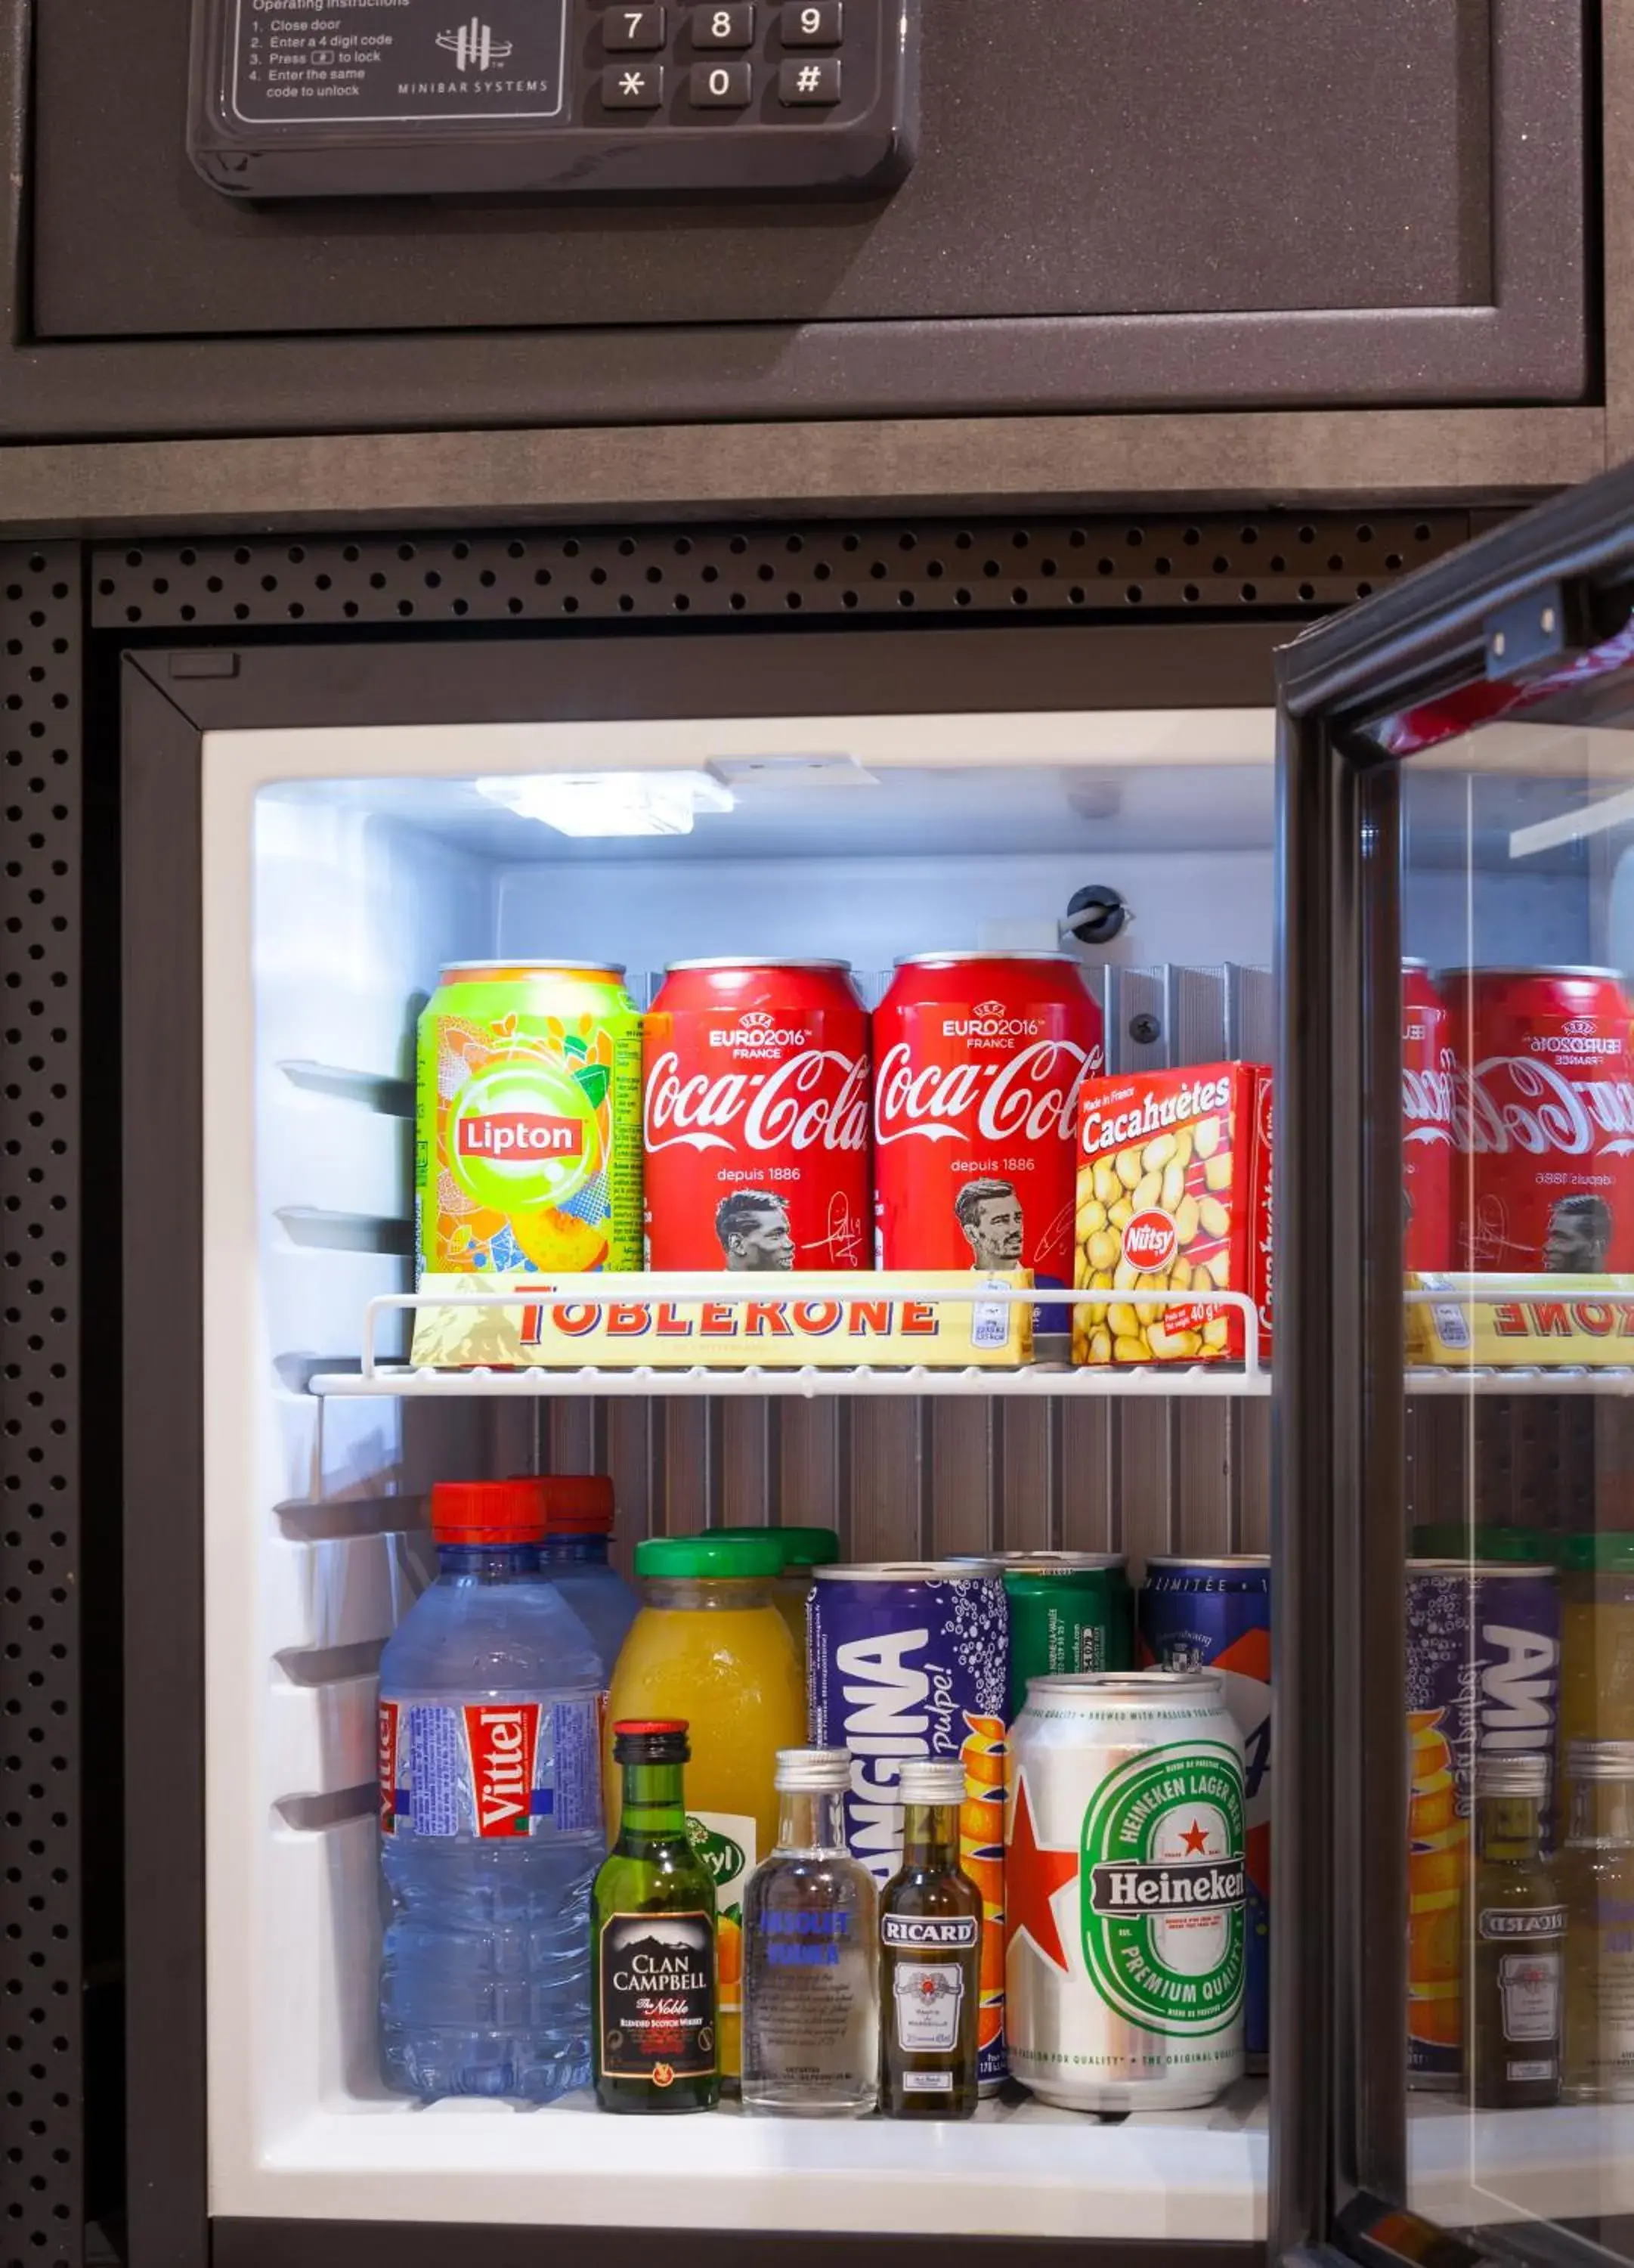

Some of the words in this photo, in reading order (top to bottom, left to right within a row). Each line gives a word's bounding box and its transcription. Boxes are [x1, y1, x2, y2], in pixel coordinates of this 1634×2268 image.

[271, 20, 308, 31] Close
[311, 19, 341, 30] door
[623, 12, 644, 39] 7
[710, 11, 732, 38] 8
[800, 8, 821, 34] 9
[270, 36, 305, 48] Enter
[308, 39, 316, 48] a
[318, 36, 327, 47] 4
[330, 36, 357, 49] digit
[361, 34, 393, 46] code
[269, 52, 307, 64] Press
[339, 51, 351, 63] to
[354, 50, 382, 62] lock
[268, 70, 303, 81] Enter
[306, 69, 326, 79] the
[330, 69, 365, 79] same
[398, 82, 468, 94] MINIBAR
[474, 80, 548, 92] SYSTEMS
[709, 69, 729, 95] 0
[797, 66, 822, 92] #
[267, 86, 298, 98] code
[302, 85, 314, 97] to
[317, 84, 360, 96] unlock
[732, 1049, 781, 1059] FRANCE
[967, 1038, 1015, 1049] FRANCE
[644, 1050, 869, 1153] Coca-Cola
[874, 1040, 1104, 1145] Coca-Col
[1082, 1076, 1230, 1154] Cacahuètes
[466, 1122, 573, 1155] Lipton
[716, 1168, 764, 1182] depuis
[769, 1167, 801, 1180] 1886
[951, 1159, 999, 1173] depuis
[1003, 1158, 1035, 1171] 1886
[514, 1286, 940, 1345] TOBLERONE
[924, 1663, 958, 1754] pulpe!
[481, 1710, 524, 1828] Vittel
[837, 1628, 930, 1892] ANGINA
[1119, 1777, 1186, 1844] HEINEKEN
[1190, 1775, 1230, 1802] LAGER
[1109, 1870, 1244, 1904] Heineken
[887, 1923, 972, 1941] RICARD
[632, 1954, 689, 1974] CLAN
[1121, 1944, 1196, 2003] PREMIUM
[1202, 1938, 1242, 2000] QUALITY
[613, 1972, 707, 1991] CAMPBELL
